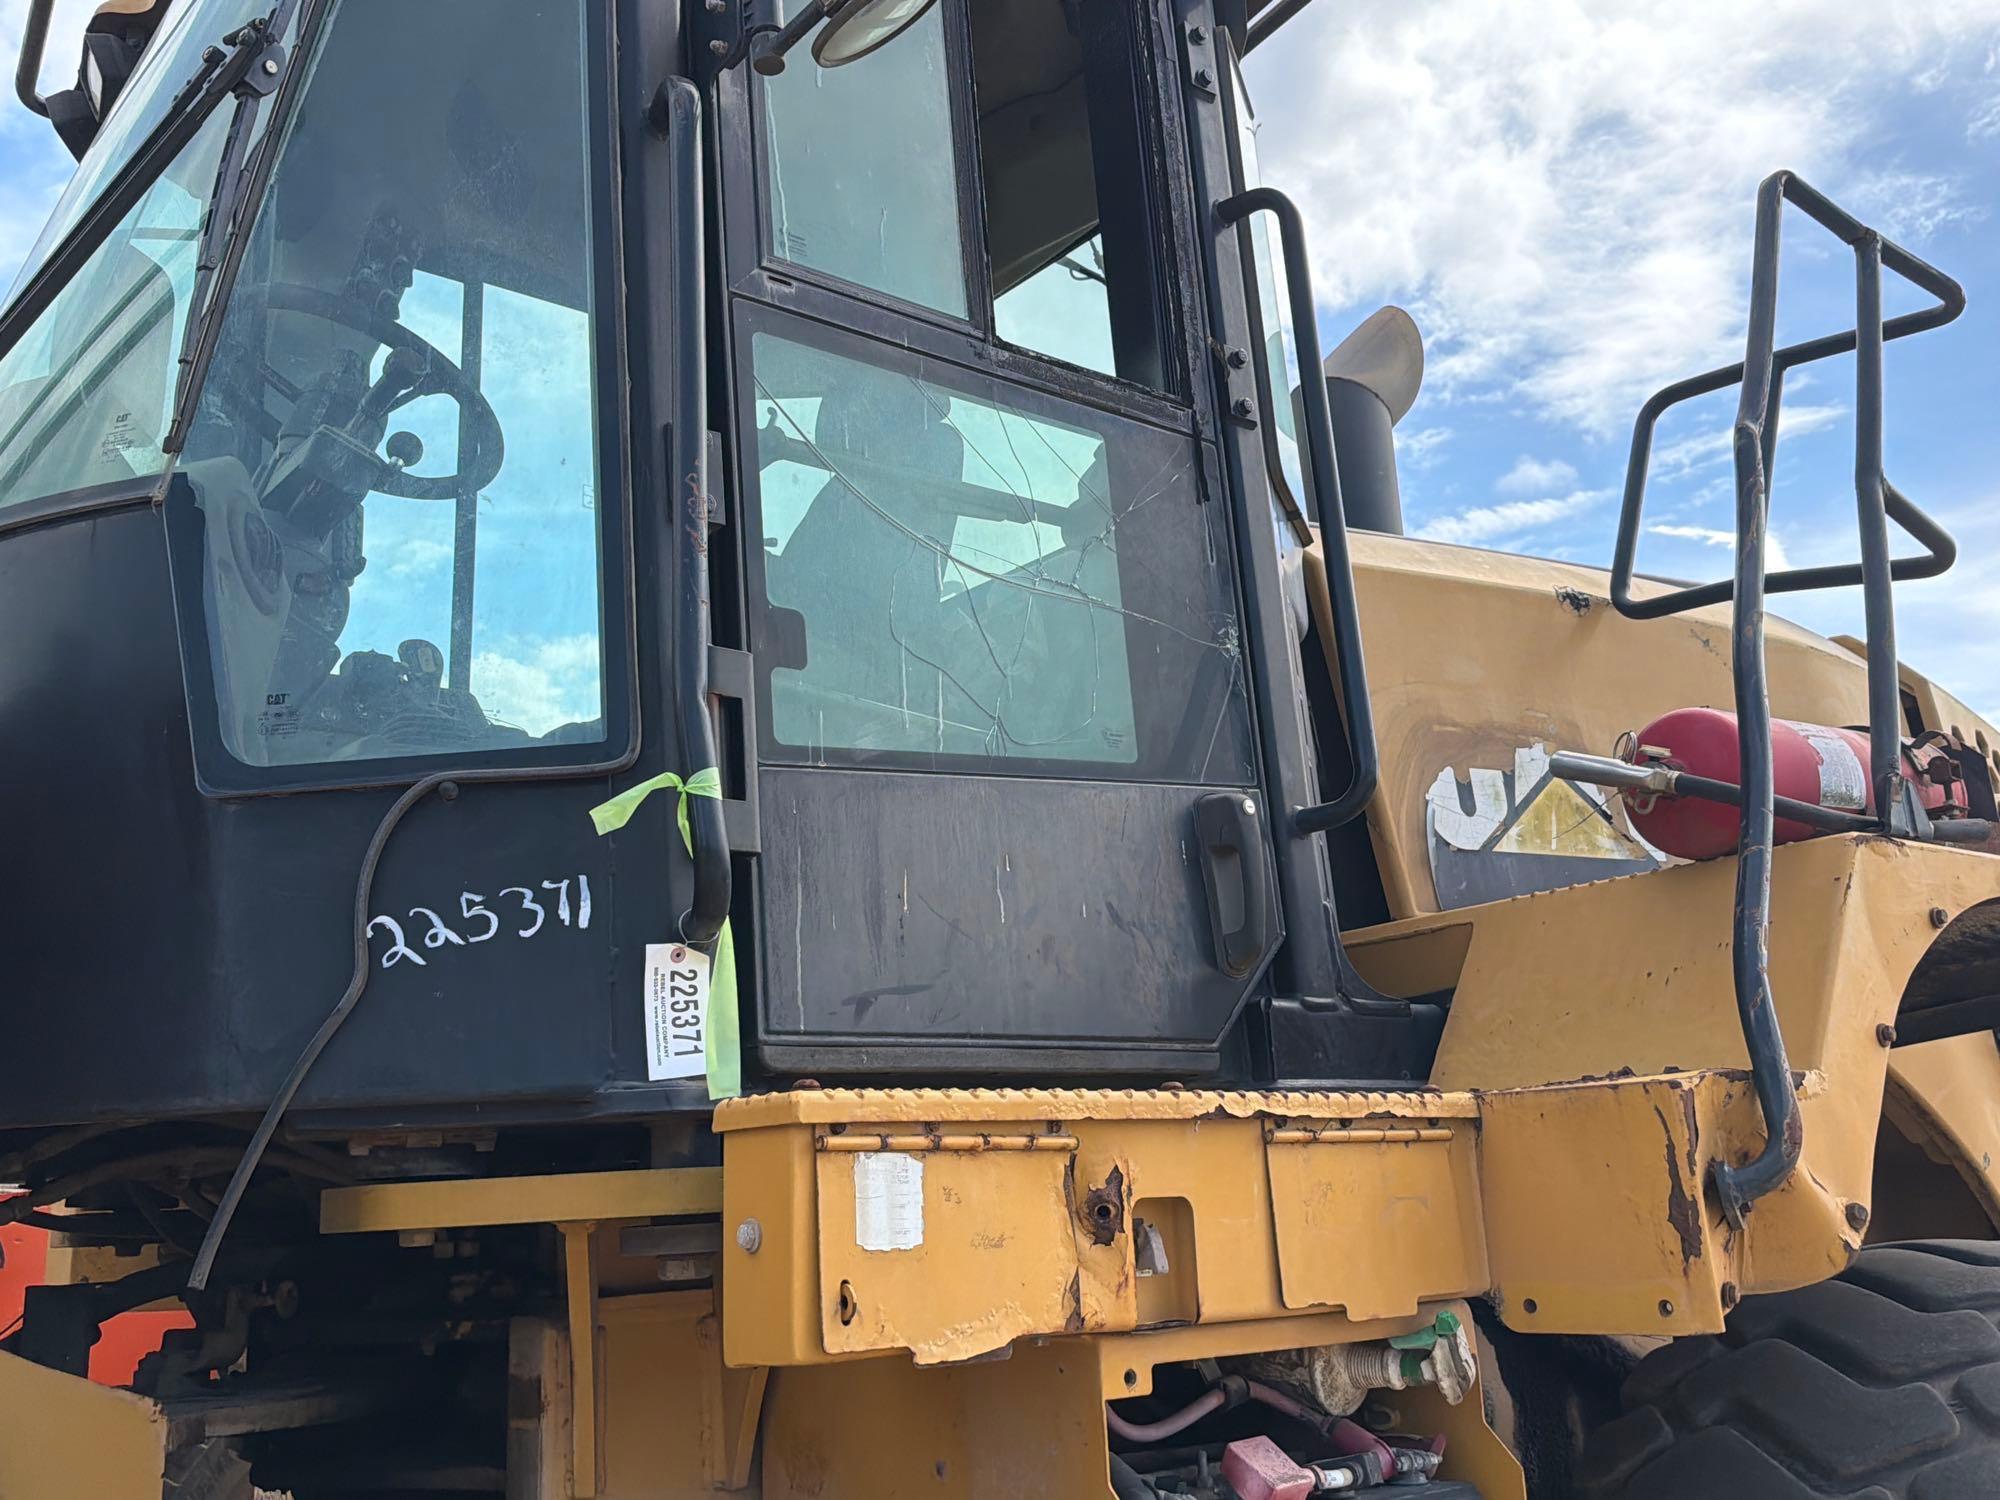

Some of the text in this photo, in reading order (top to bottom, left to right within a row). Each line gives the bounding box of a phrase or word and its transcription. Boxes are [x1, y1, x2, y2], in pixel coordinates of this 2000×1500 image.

[266, 693, 288, 705] CAT
[366, 874, 592, 968] 225371
[662, 1026, 670, 1058] COMPANY
[670, 969, 704, 1057] 225371
